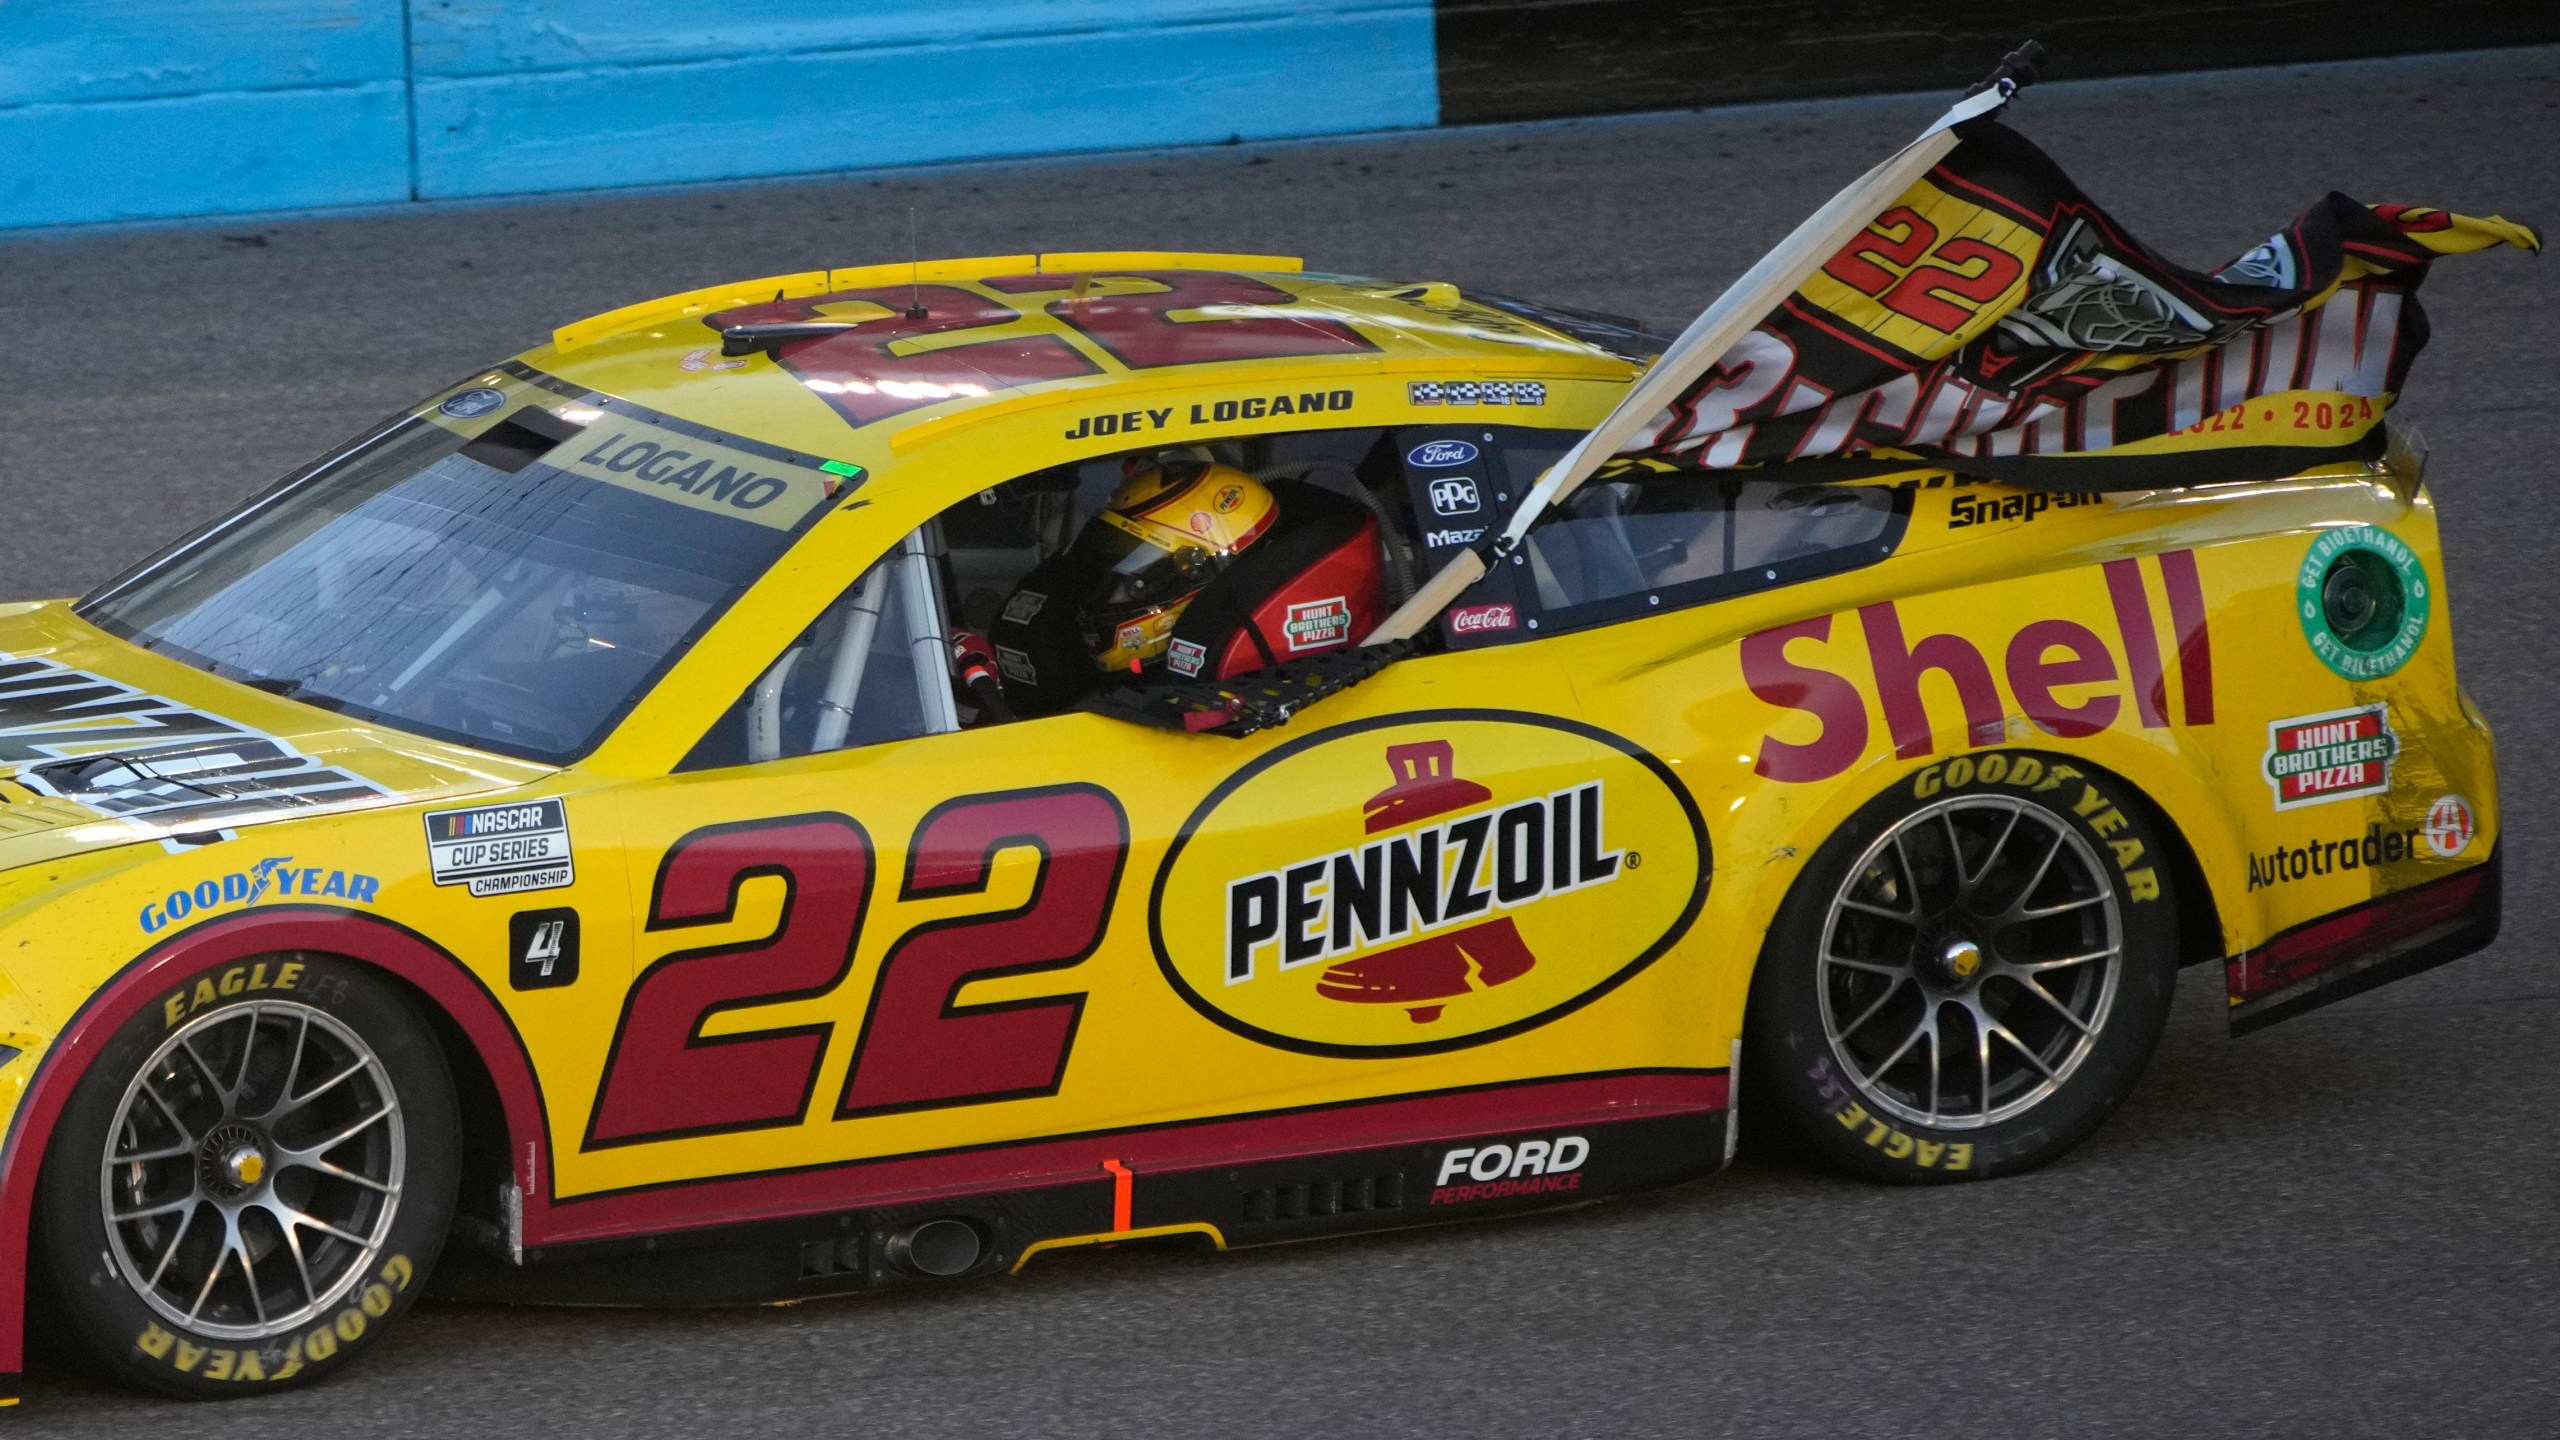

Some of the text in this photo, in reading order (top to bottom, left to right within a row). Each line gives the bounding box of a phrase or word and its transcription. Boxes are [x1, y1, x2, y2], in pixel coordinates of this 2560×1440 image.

[1822, 206, 2024, 335] 22
[701, 270, 1386, 430] 22
[1065, 390, 1353, 440] JOEY LOGANO
[2294, 396, 2373, 430] 2024
[579, 433, 788, 510] LOGANO
[1422, 443, 1466, 463] Ford
[1433, 482, 1477, 511] PPG
[2302, 526, 2415, 589] GET BIOETHANOL
[1290, 614, 1346, 633] BROTHERS
[1302, 605, 1334, 620] HUNT
[1303, 627, 1336, 642] PIZZA
[2313, 631, 2341, 661] GET
[1740, 549, 2214, 783] Shell
[2297, 720, 2361, 750] HUNT
[2273, 737, 2388, 776] BROTHERS
[2298, 763, 2366, 793] PIZZA
[472, 806, 544, 834] NASCAR
[452, 838, 550, 867] CUP SERIES
[2248, 822, 2420, 893] Autotrader
[475, 869, 569, 894] CHAMPIONSHIP
[1227, 780, 1625, 986] PENNZOIL
[525, 920, 564, 976] 4
[579, 781, 1131, 1154] 22
[164, 963, 305, 1029] EAGLE
[1835, 1100, 1974, 1170] EAGLE
[1436, 1136, 1590, 1186] FORD
[1430, 1173, 1583, 1205] PERFORMANCE
